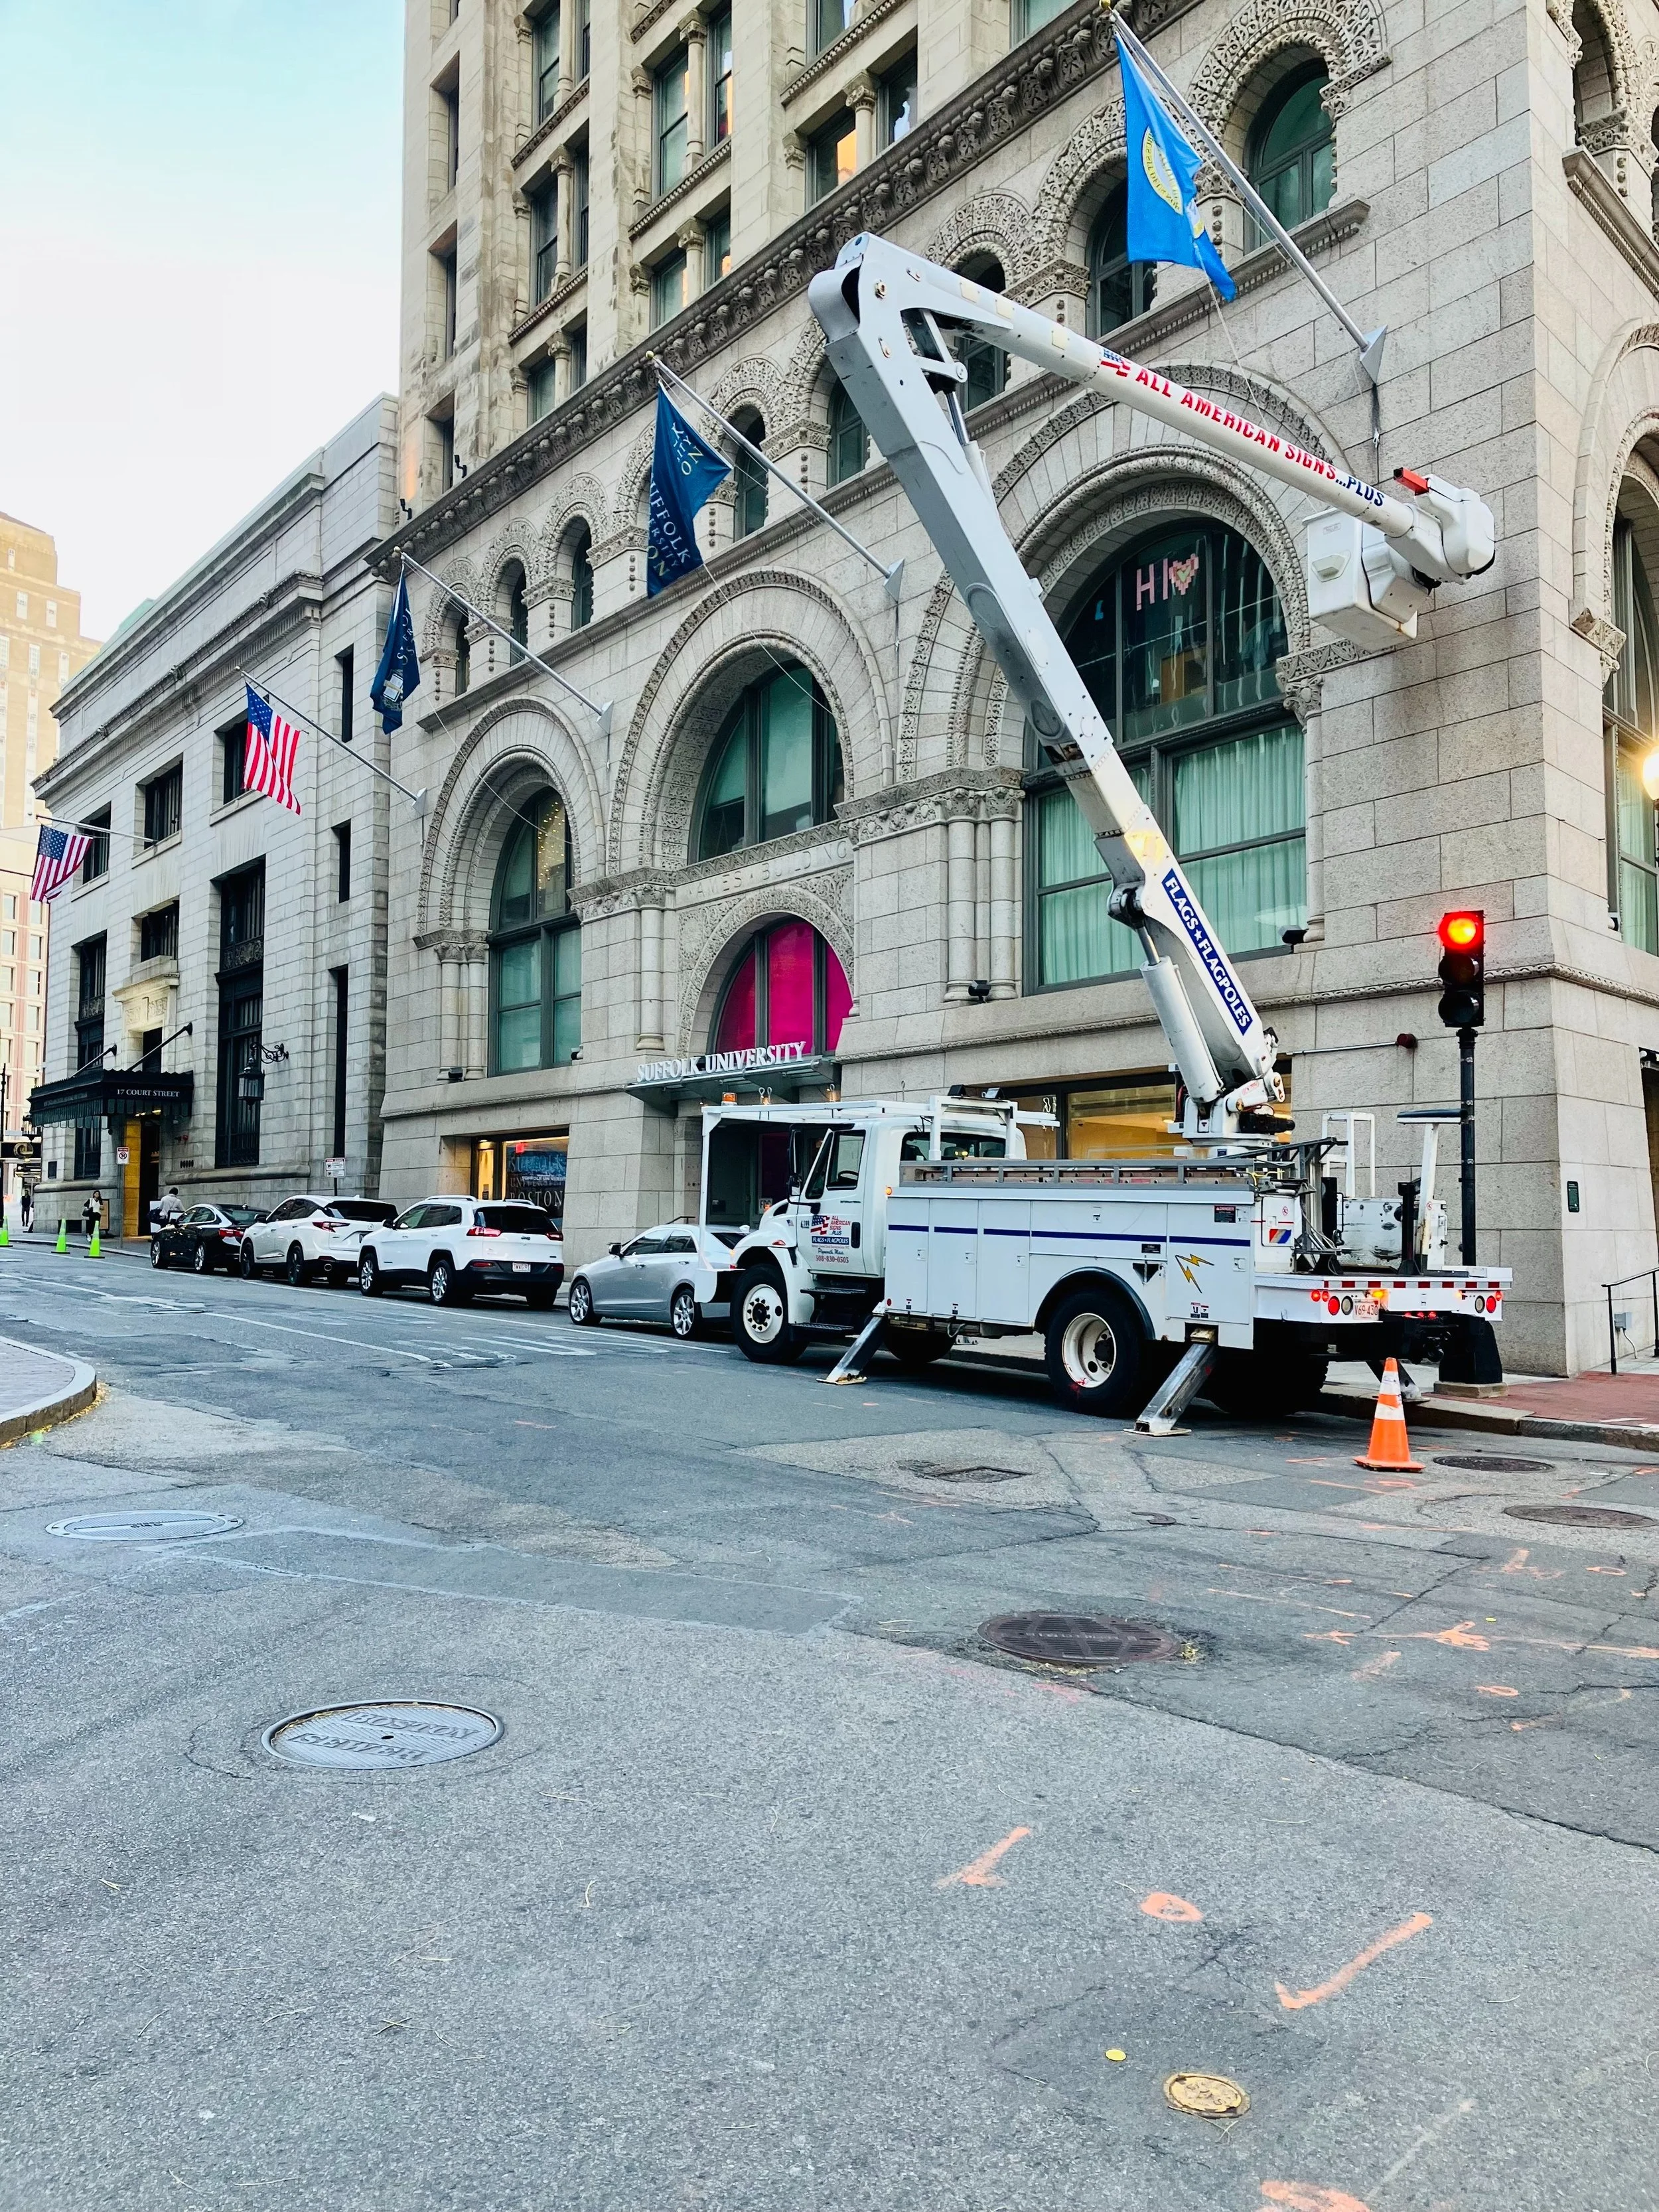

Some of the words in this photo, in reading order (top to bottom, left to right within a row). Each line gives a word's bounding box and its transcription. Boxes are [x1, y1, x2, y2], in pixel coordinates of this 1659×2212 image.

[1135, 368, 1171, 398] ALL
[1180, 392, 1280, 453] AMERICAN
[650, 473, 691, 563] UFFOLK
[1136, 558, 1169, 611] HI
[1165, 877, 1199, 930] FLAGS
[1197, 938, 1250, 1029] FLAGPOLES
[637, 1056, 701, 1082] SUFFOLK
[705, 1041, 806, 1074] UNIVERSITY
[289, 1733, 428, 1761] SEWER
[342, 1712, 481, 1739] BOSTON
